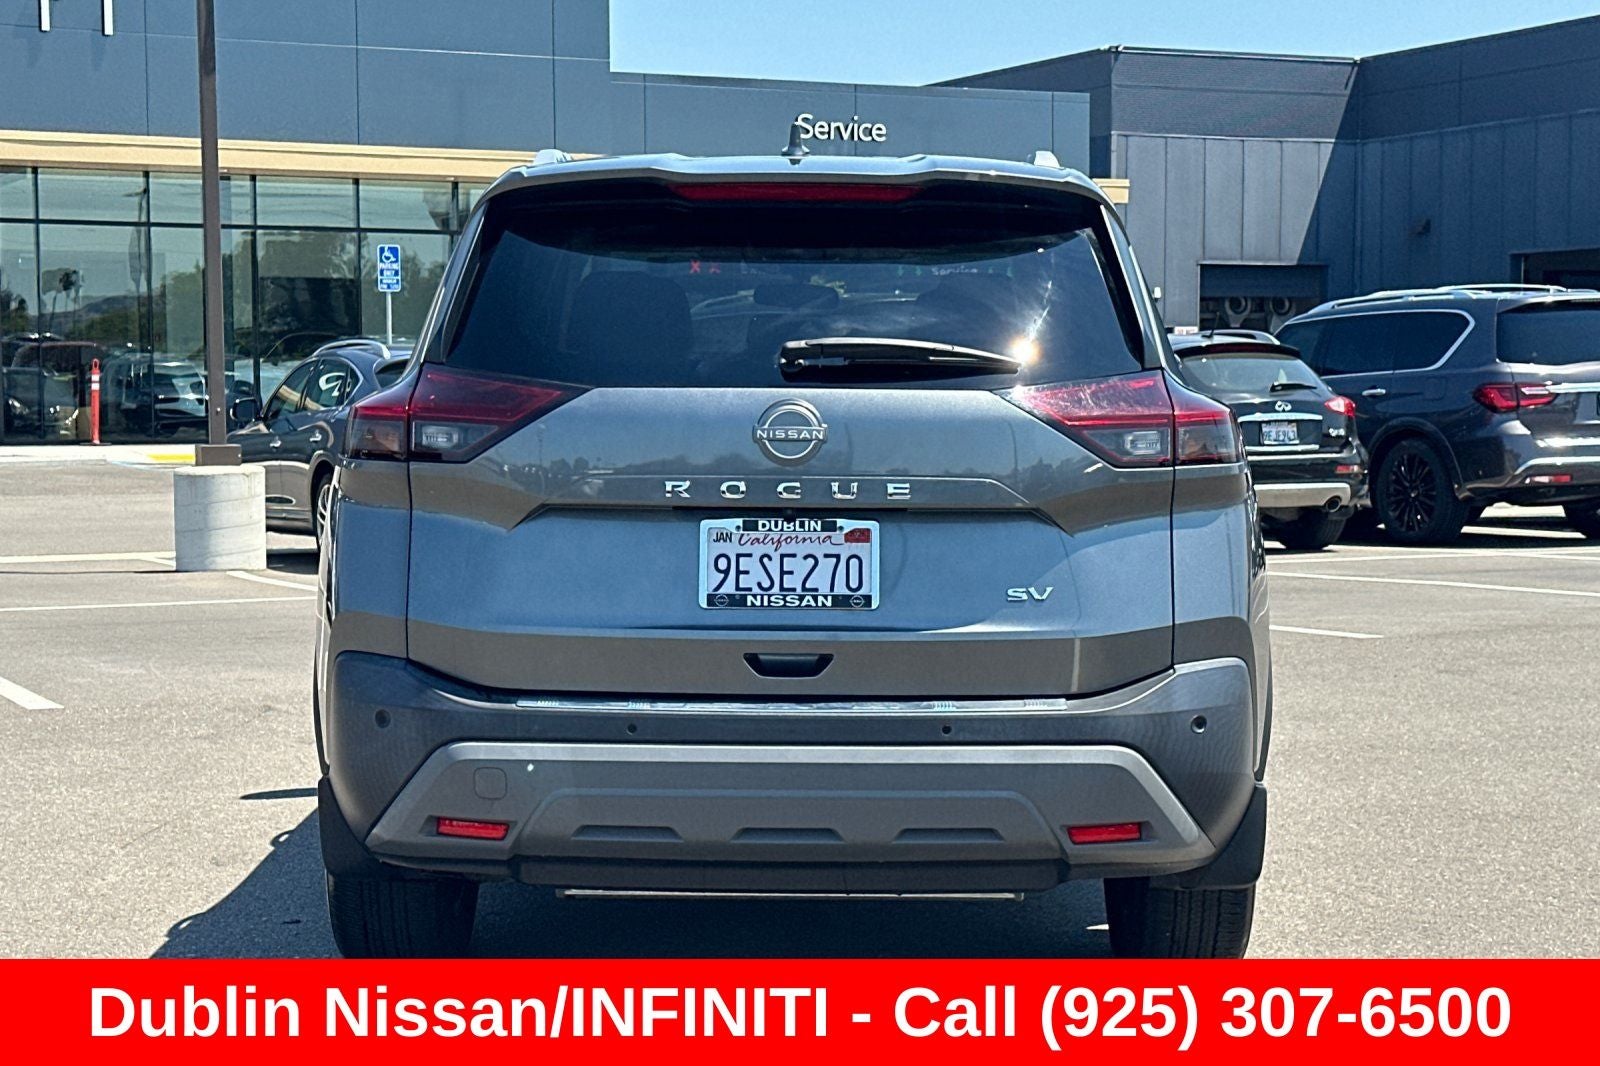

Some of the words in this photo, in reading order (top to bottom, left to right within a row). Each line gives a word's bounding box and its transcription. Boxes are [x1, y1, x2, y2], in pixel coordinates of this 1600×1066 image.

[796, 113, 888, 142] Service
[756, 429, 824, 441] NISSAN
[664, 480, 912, 501] ROGUE
[757, 519, 822, 532] DUBLIN
[712, 532, 734, 543] JAN
[738, 532, 846, 553] California
[712, 552, 864, 593] 9ESE270
[746, 594, 833, 607] NISSAN
[1006, 586, 1054, 601] SV
